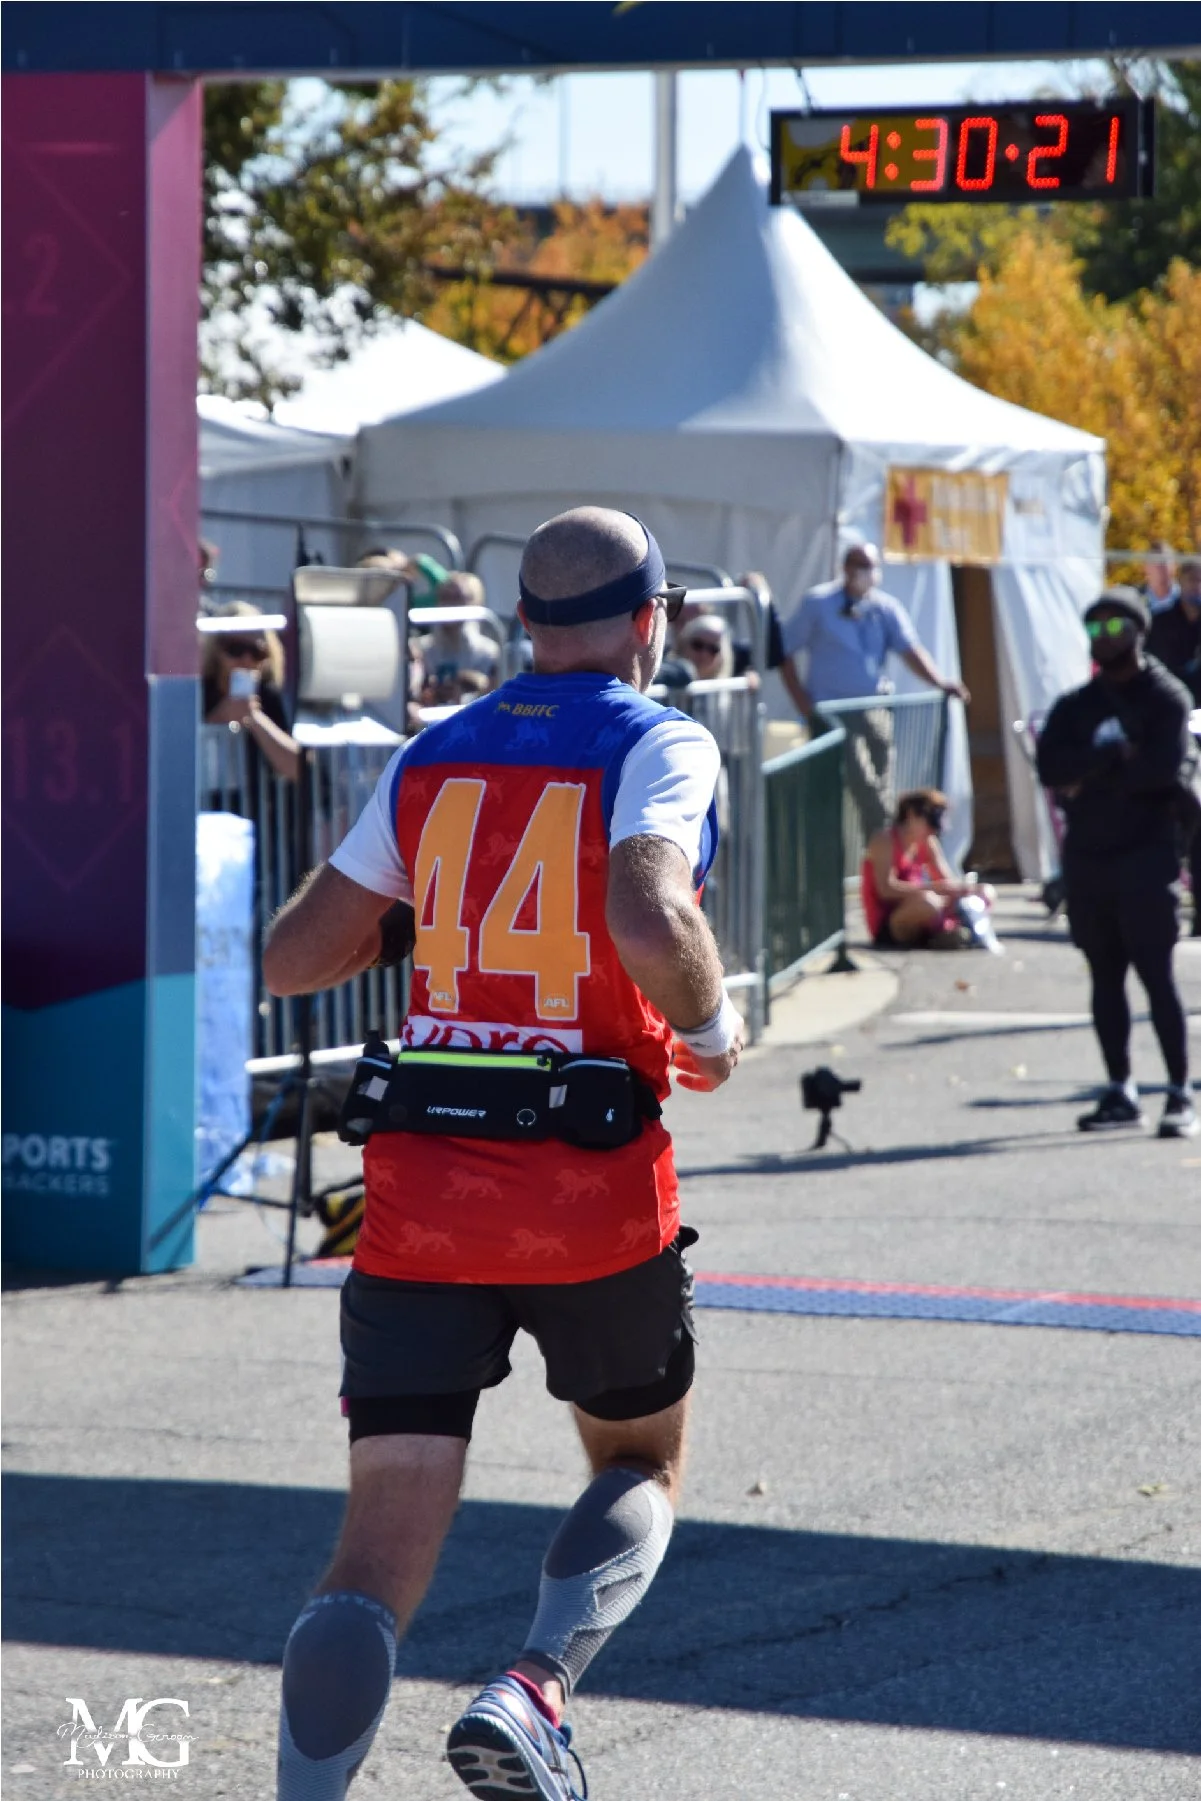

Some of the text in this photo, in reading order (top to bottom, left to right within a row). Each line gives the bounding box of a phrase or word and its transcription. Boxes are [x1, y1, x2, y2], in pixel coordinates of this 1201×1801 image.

[4, 715, 134, 806] 13.1
[413, 778, 591, 1021] 44
[543, 997, 570, 1008] AFL
[427, 1106, 487, 1118] URPOWER
